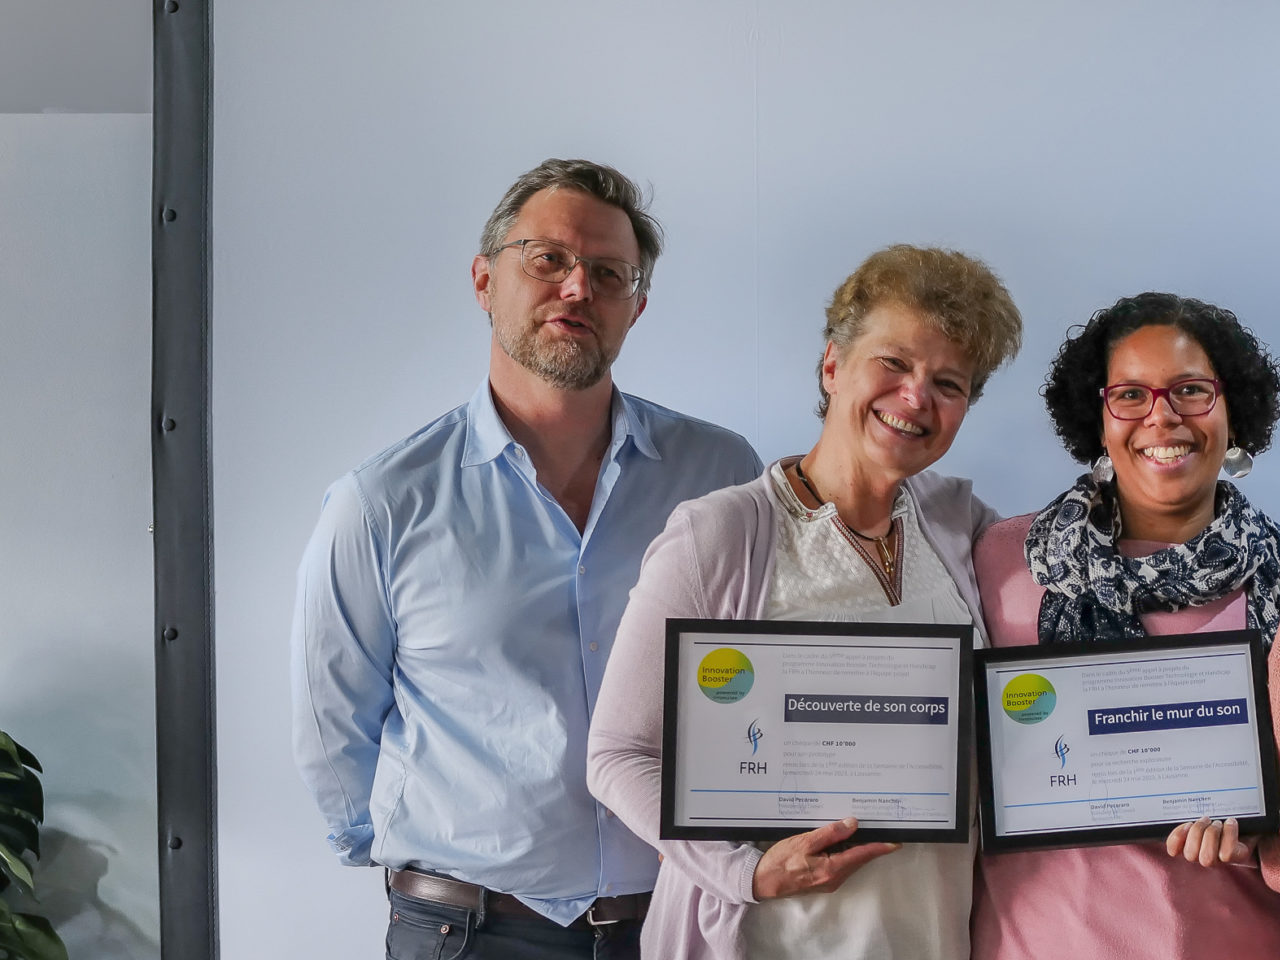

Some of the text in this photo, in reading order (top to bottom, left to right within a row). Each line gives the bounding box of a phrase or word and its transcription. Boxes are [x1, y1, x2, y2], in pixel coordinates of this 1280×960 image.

[702, 666, 746, 674] Innovation
[1006, 690, 1047, 699] Innovation
[788, 698, 945, 716] Découverte de son corps
[1095, 705, 1240, 725] Franchir le mur du son
[740, 762, 767, 774] FRH
[1050, 774, 1077, 788] FRH
